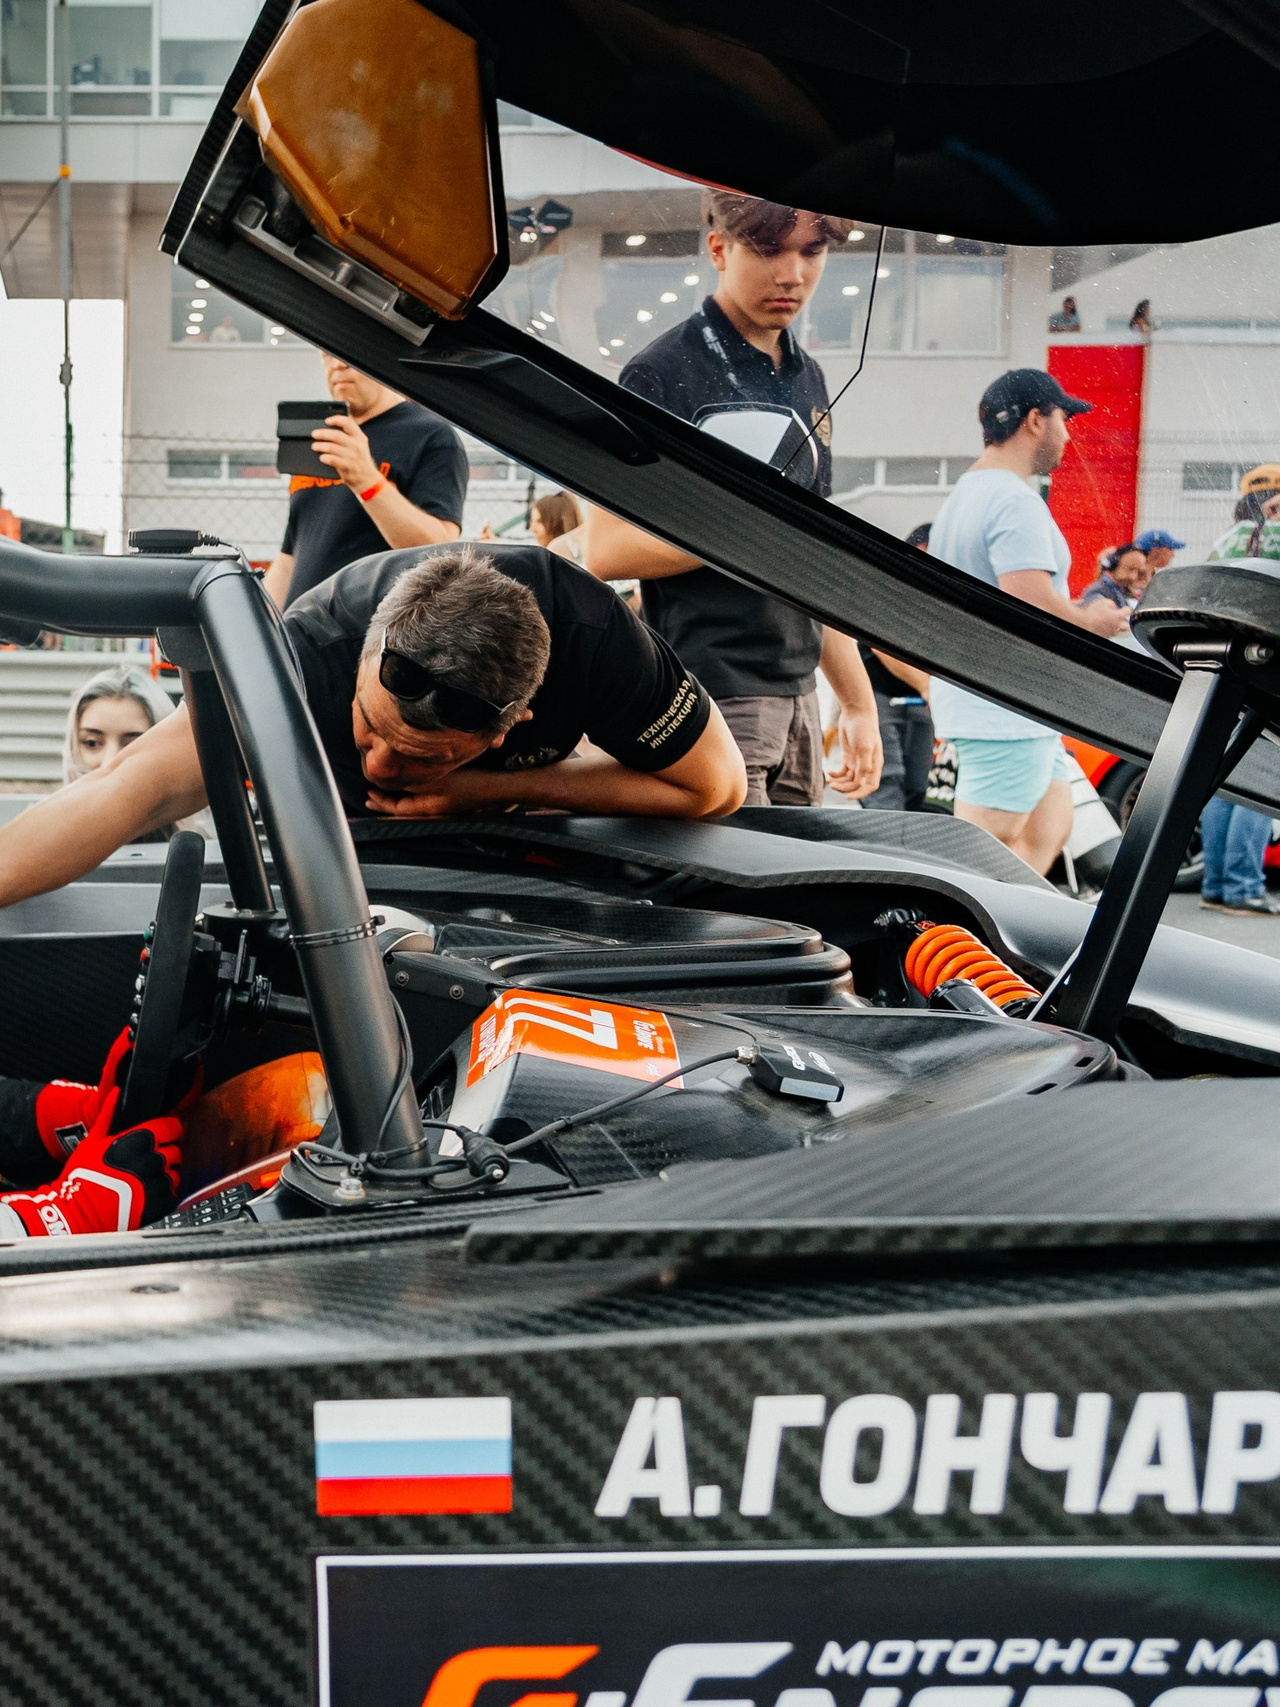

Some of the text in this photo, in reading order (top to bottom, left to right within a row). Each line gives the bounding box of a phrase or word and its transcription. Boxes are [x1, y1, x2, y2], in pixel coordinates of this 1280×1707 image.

[637, 679, 692, 744] ТЕХНИЧЕСКАЯ
[649, 692, 698, 749] ИНСПЕКЦИЯ
[816, 1637, 1179, 1678] МОТОРНОЕ
